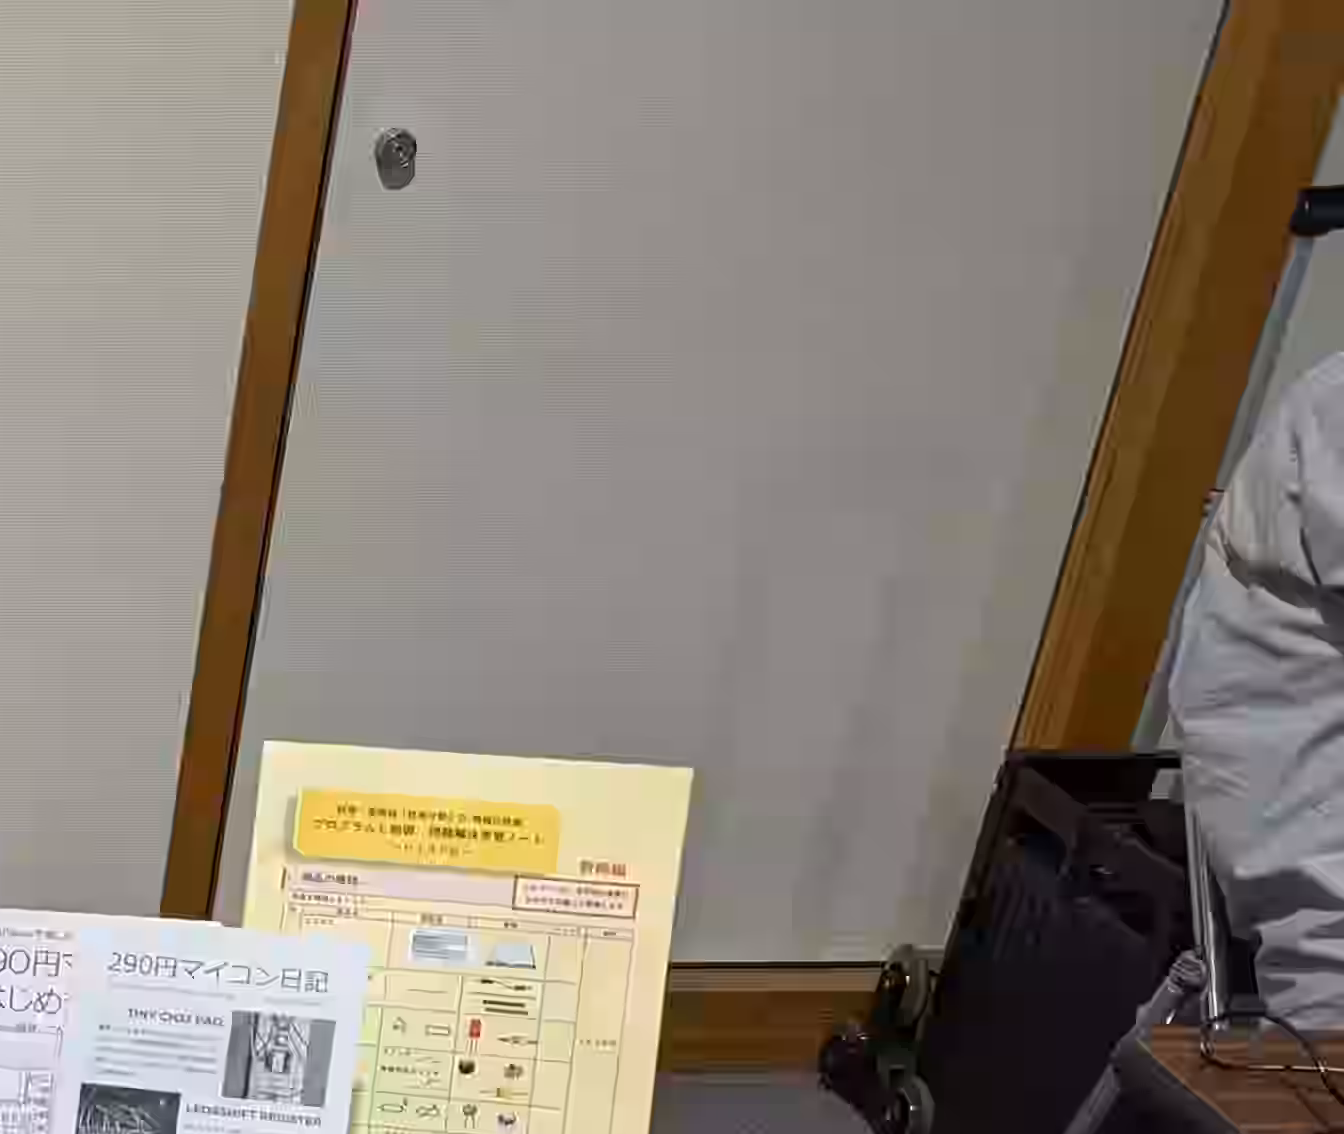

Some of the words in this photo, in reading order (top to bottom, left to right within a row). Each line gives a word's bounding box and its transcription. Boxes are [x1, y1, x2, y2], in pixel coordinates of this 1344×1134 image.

[108, 951, 329, 994] 290円マイコン日記
